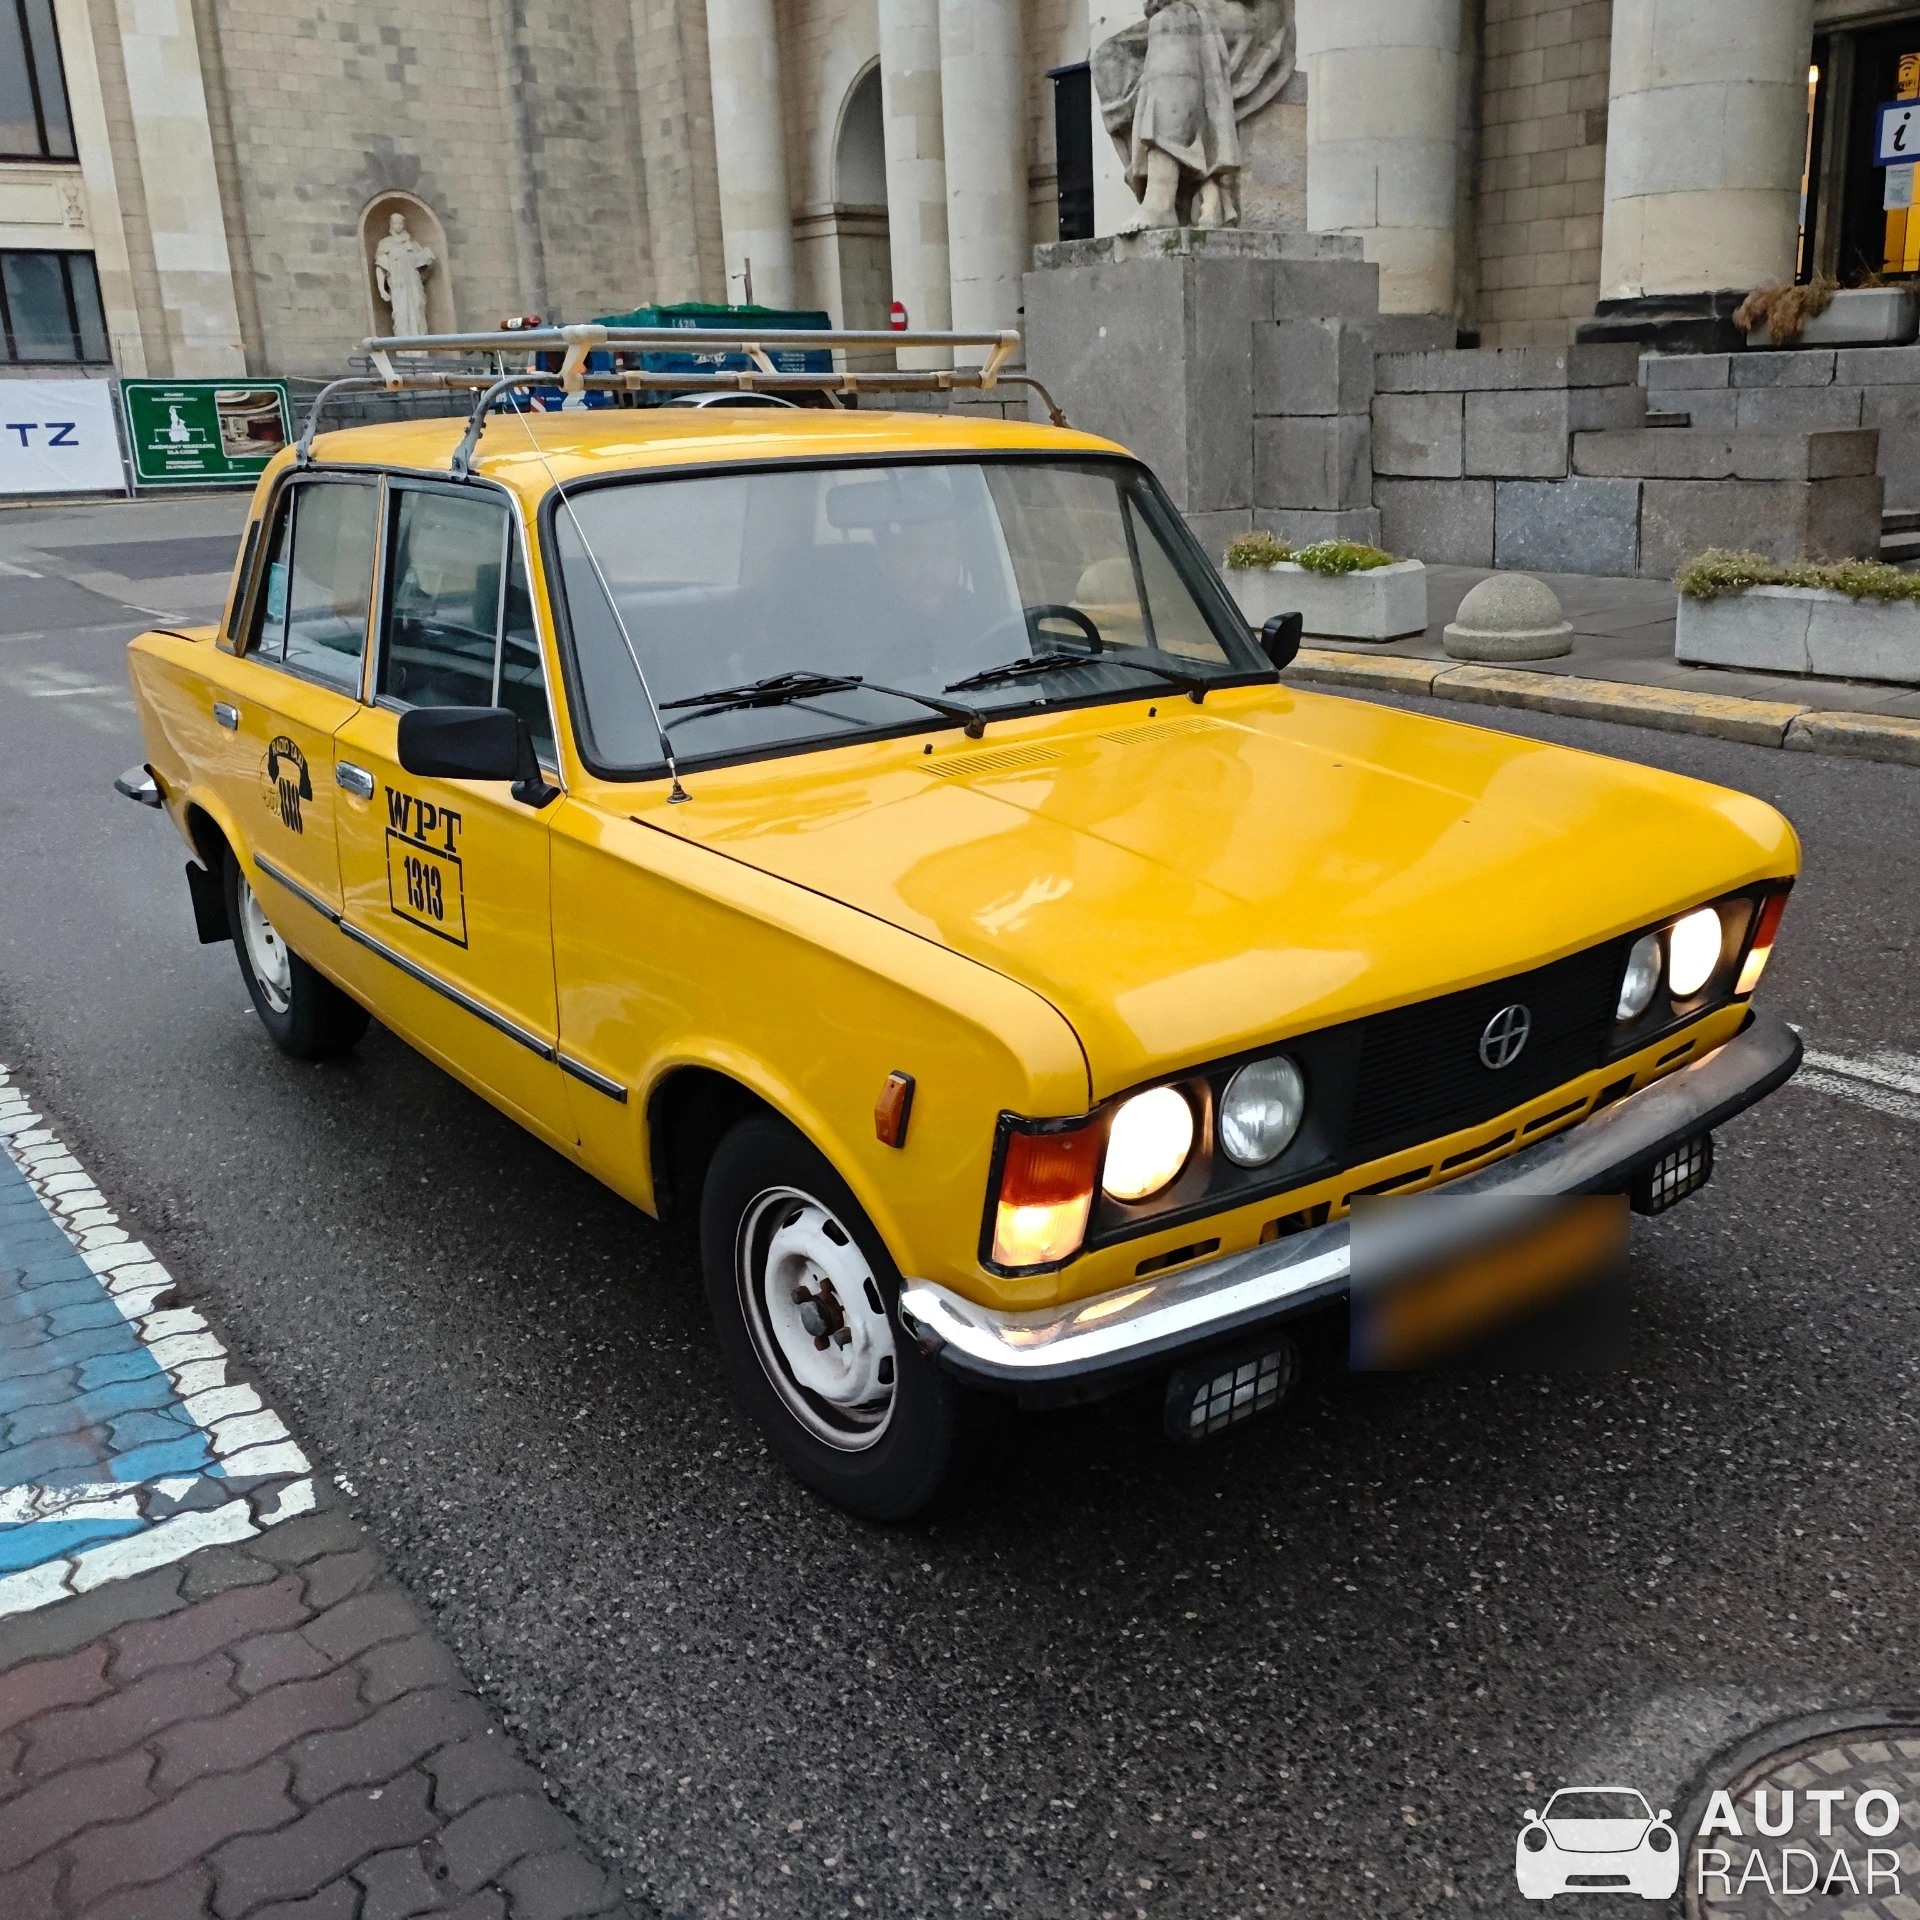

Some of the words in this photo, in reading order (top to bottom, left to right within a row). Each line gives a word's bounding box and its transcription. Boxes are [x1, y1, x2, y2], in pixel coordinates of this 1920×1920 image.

[6, 422, 79, 447] TZ
[272, 738, 289, 756] RADIO
[291, 742, 303, 769] TAXI
[385, 786, 461, 853] WPT
[404, 855, 443, 921] 1313
